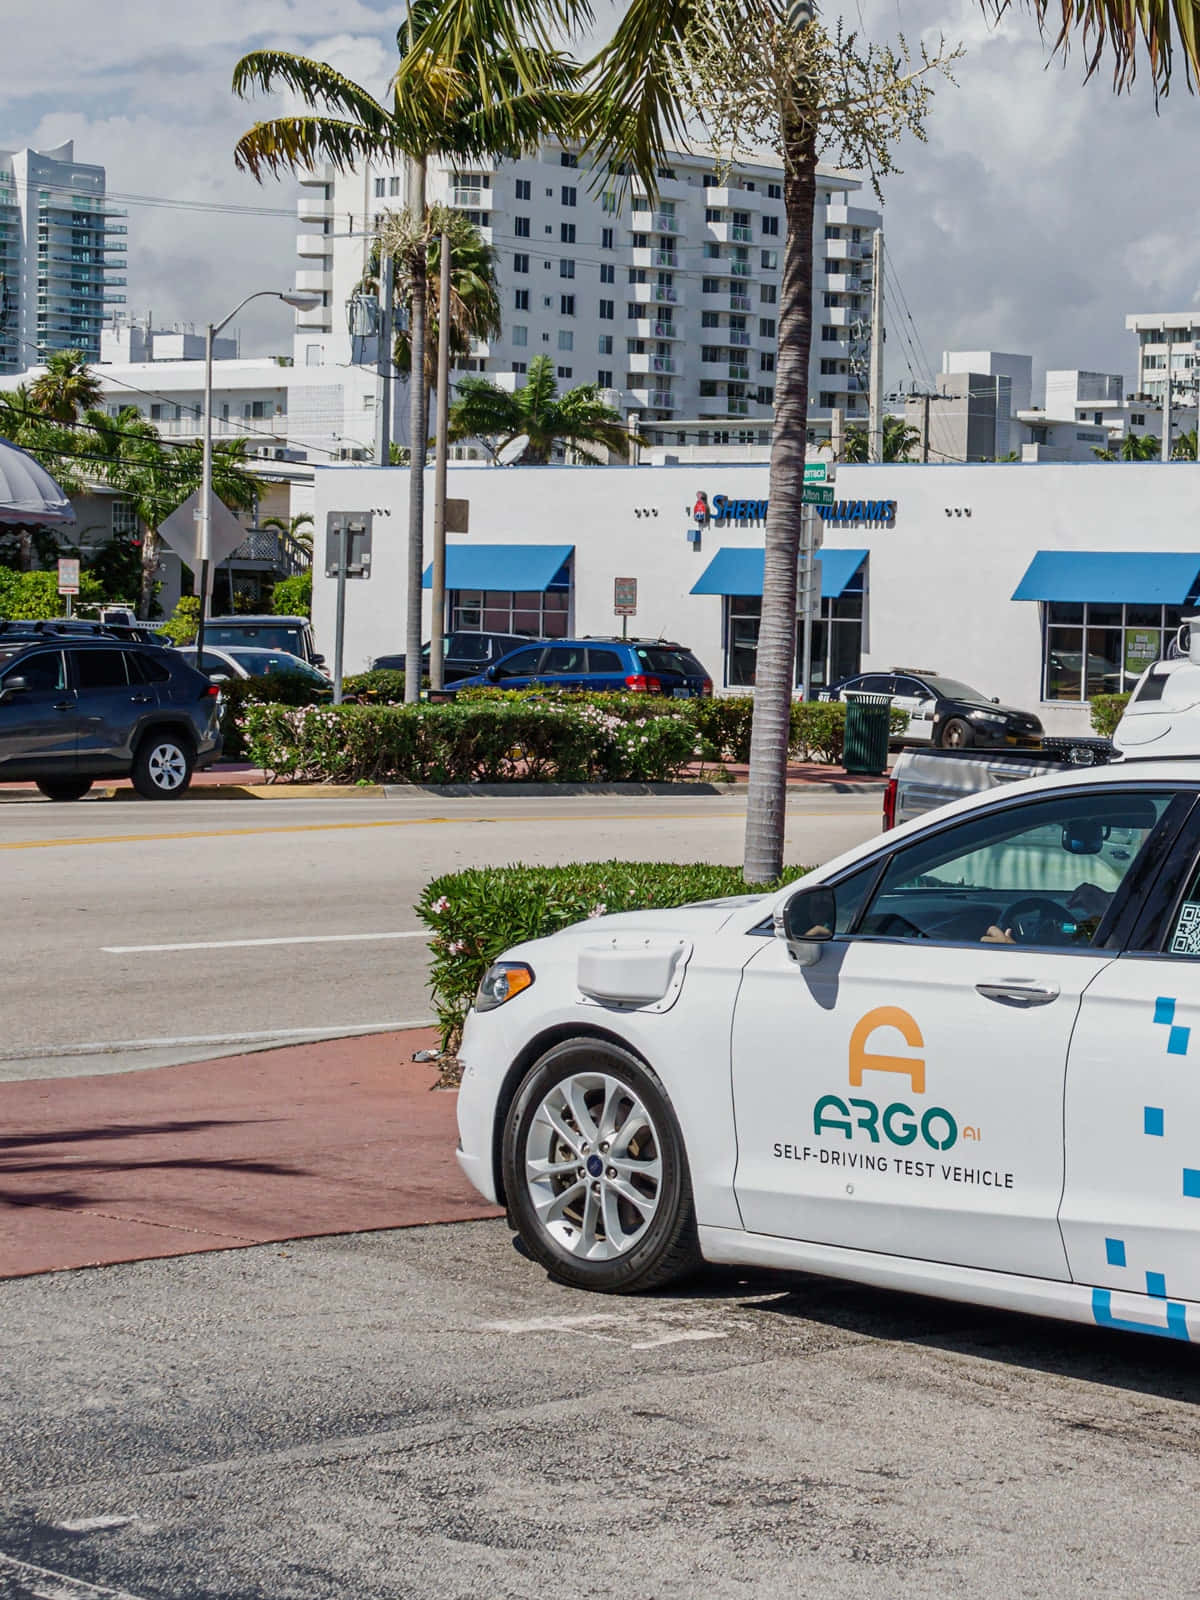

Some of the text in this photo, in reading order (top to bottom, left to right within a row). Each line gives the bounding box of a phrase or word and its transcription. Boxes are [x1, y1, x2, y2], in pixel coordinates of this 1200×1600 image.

[813, 1094, 981, 1151] ARGO AI
[773, 1143, 1014, 1189] SELF-DRIVING TEST VEHICLE
